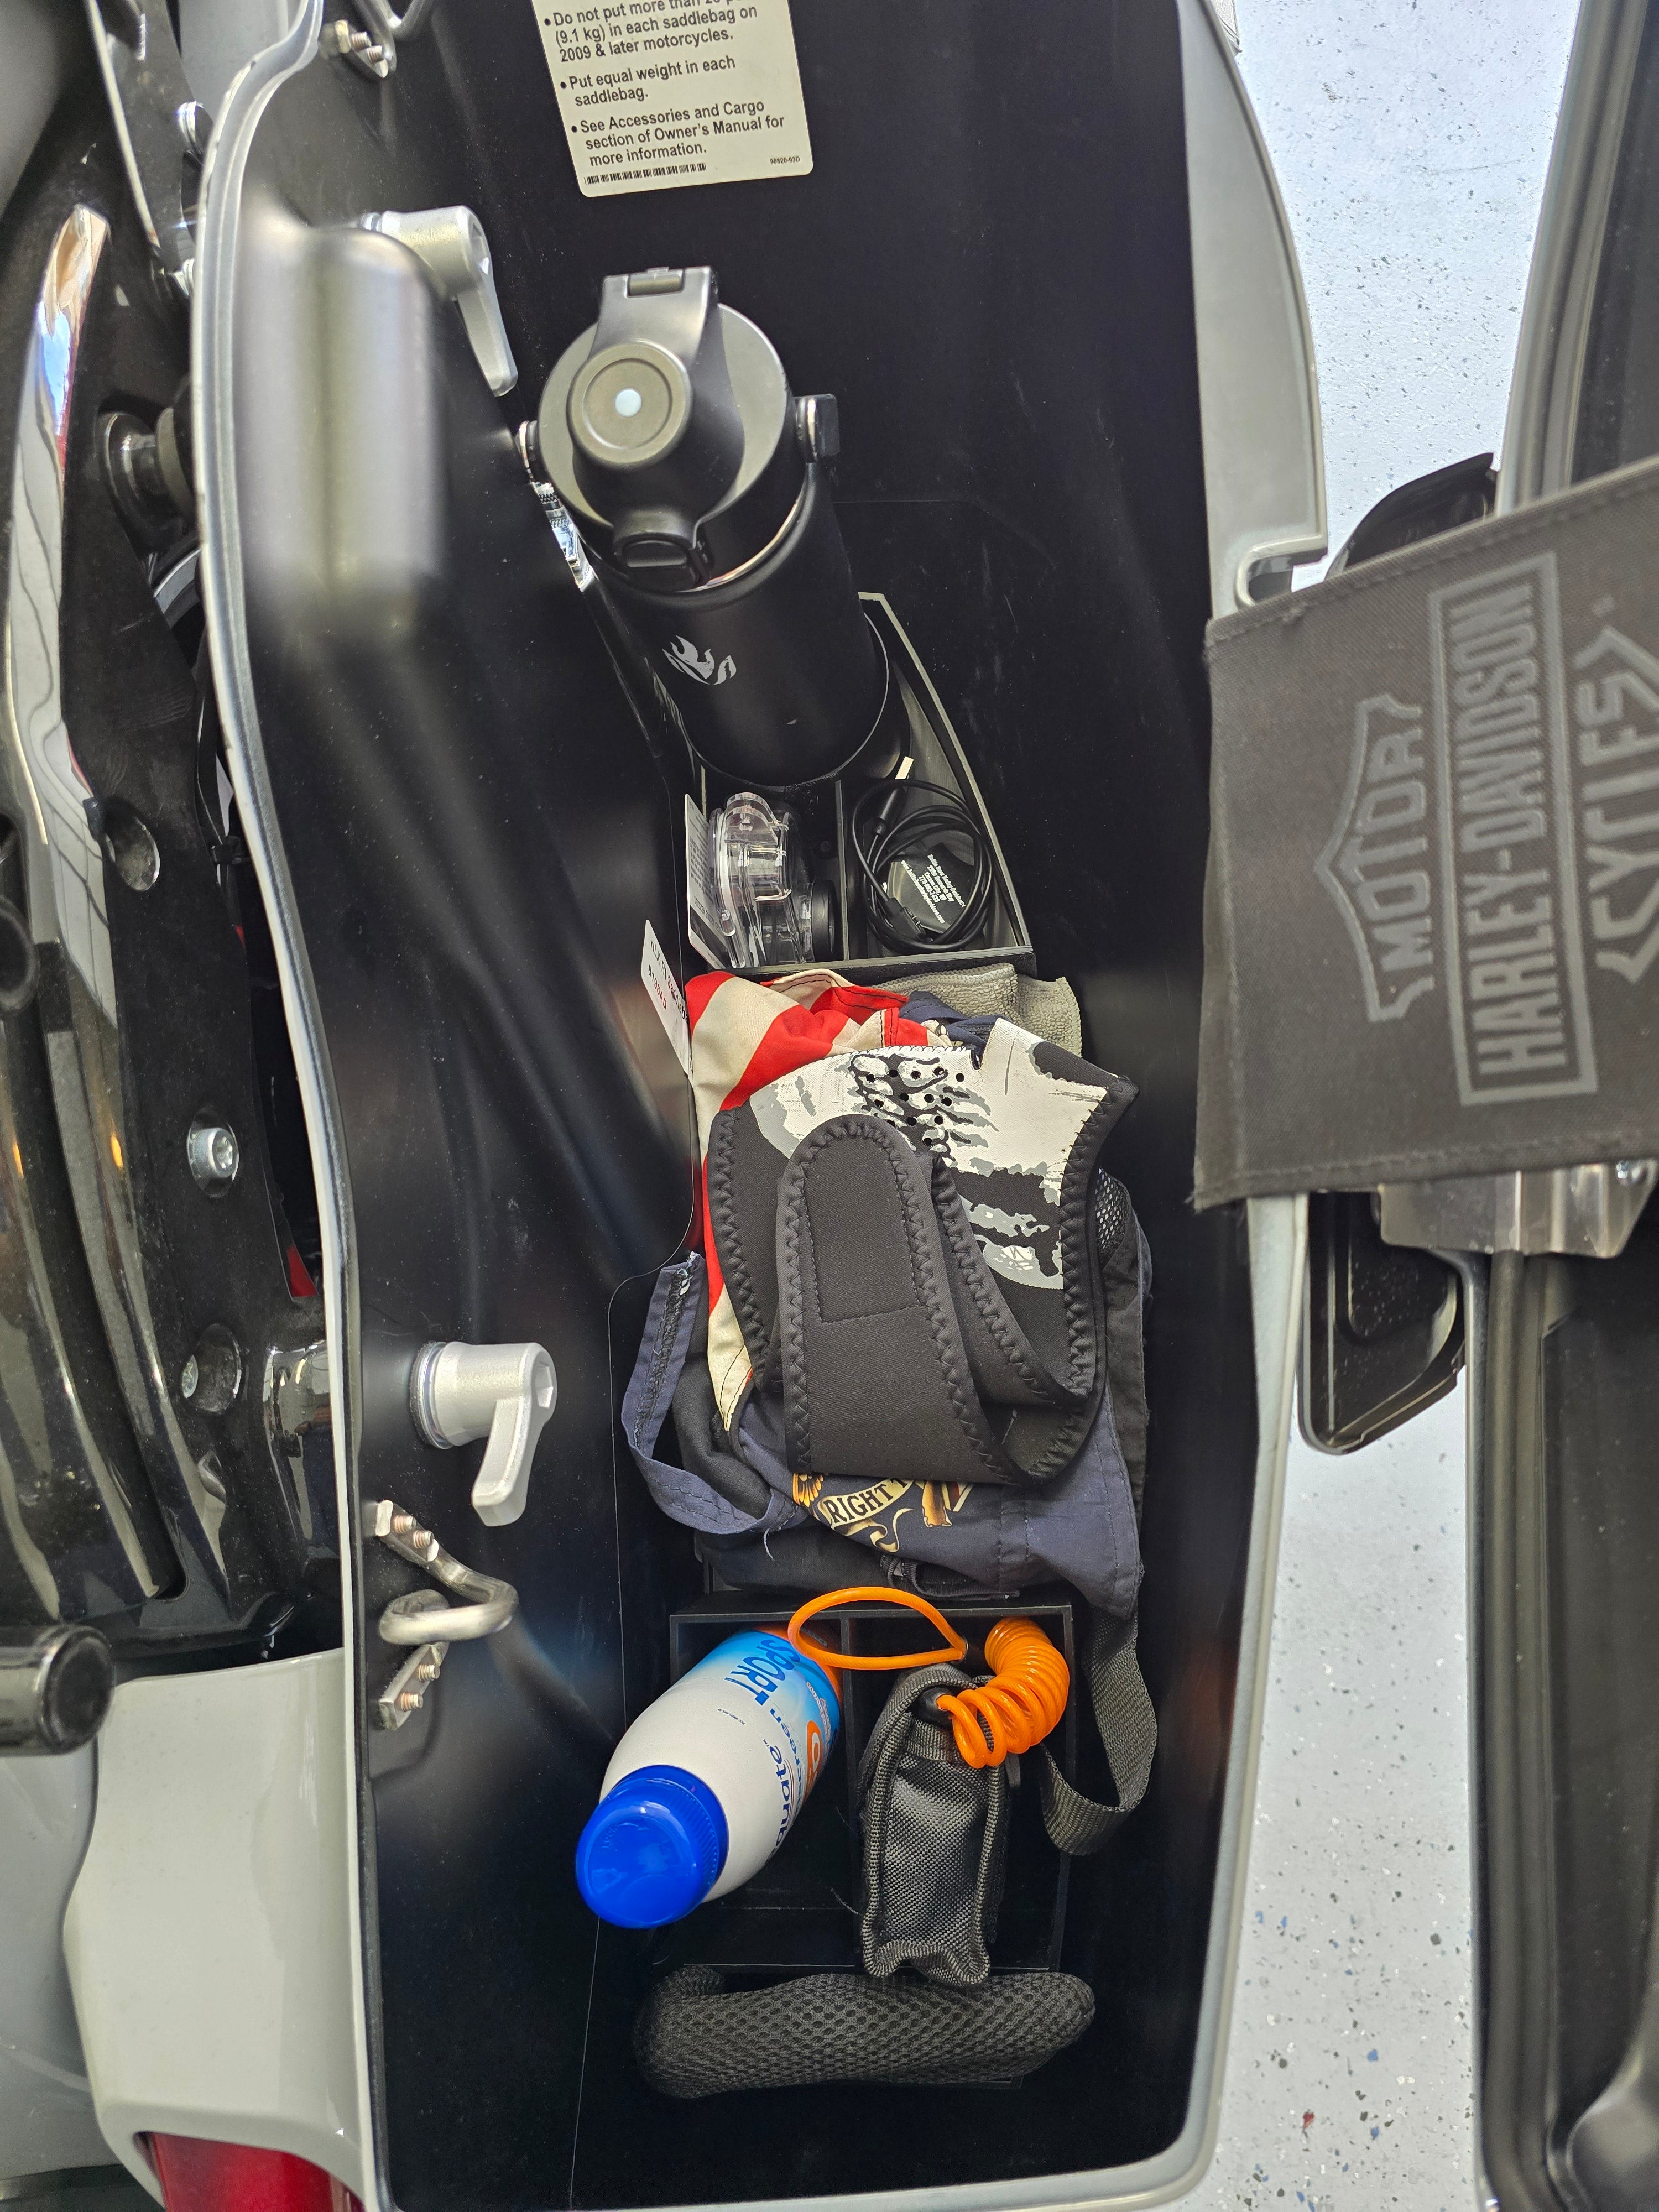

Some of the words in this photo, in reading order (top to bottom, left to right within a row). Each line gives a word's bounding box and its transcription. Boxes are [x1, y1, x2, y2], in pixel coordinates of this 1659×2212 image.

[553, 12, 573, 26] Do
[577, 7, 600, 23] not
[603, 3, 627, 22] put
[629, 0, 665, 15] more
[555, 28, 579, 48] (9.1
[583, 24, 606, 42] kg)
[609, 23, 622, 36] in
[626, 17, 659, 34] each
[663, 9, 736, 29] saddlebag
[739, 7, 758, 19] on
[559, 45, 591, 62] 2009
[596, 43, 606, 57] &
[608, 39, 639, 55] later
[643, 28, 733, 50] motorcycles.
[568, 74, 593, 90] Put
[596, 67, 633, 87] equal
[636, 61, 683, 80] weight
[685, 61, 698, 74] in
[702, 55, 736, 72] each
[575, 87, 649, 107] saddlebag.
[580, 118, 605, 133] See
[609, 108, 691, 130] Accessories
[695, 103, 720, 119] and
[723, 101, 765, 116] Cargo
[586, 133, 634, 150] section
[638, 129, 651, 143] of
[654, 122, 709, 141] Owner's
[713, 117, 762, 135] Manual
[765, 115, 785, 128] for
[589, 153, 623, 167] more
[626, 142, 707, 162] information.
[1449, 582, 1567, 1076] HARLEY-DAVIDSON
[1339, 727, 1433, 973] MOTOR
[823, 1484, 893, 1524] RIGHT
[724, 1640, 801, 1705] SPORT
